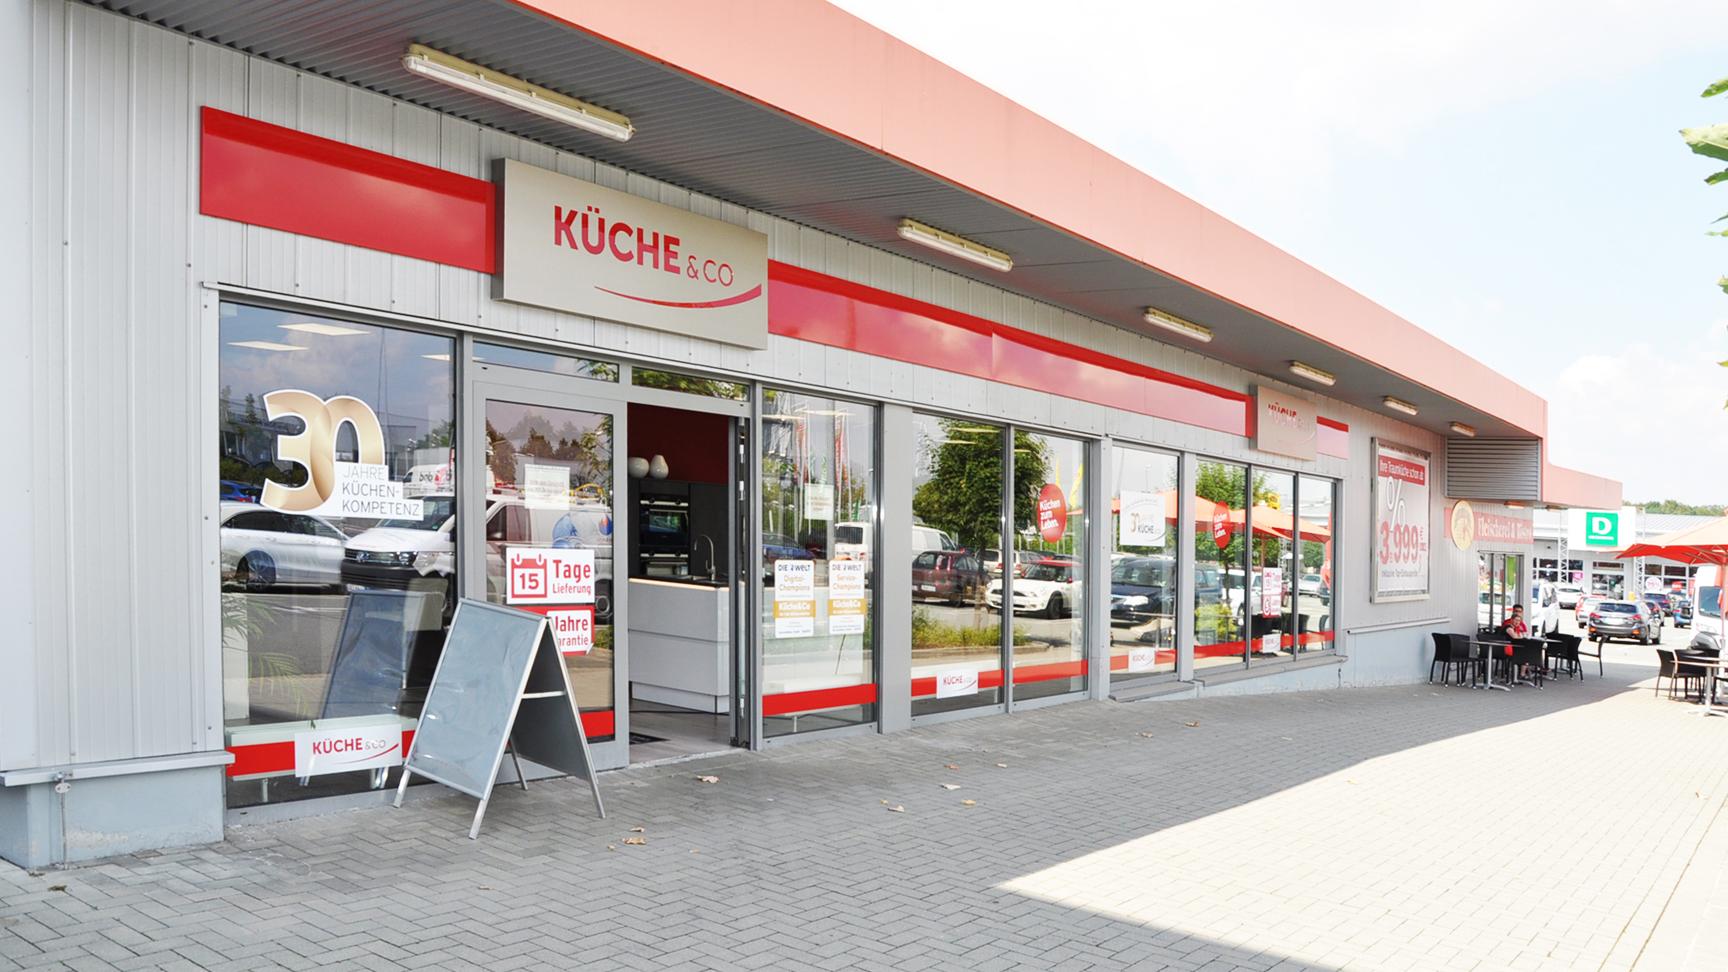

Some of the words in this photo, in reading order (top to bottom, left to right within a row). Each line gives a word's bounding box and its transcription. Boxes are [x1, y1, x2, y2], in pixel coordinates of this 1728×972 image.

[554, 204, 681, 274] KÜCHE
[261, 388, 385, 513] 30
[343, 465, 385, 480] JAHRE
[342, 480, 399, 497] KÜCHEN-
[342, 499, 419, 516] KOMPETENZ
[1039, 499, 1061, 511] Küchen
[1040, 510, 1053, 520] zum
[552, 559, 591, 583] Tage
[519, 572, 540, 590] 15
[552, 582, 592, 595] Lieferung
[555, 615, 589, 632] Jahre
[558, 634, 589, 647] rantie
[943, 676, 964, 686] KÜCHE
[312, 737, 363, 755] KÜCHE
